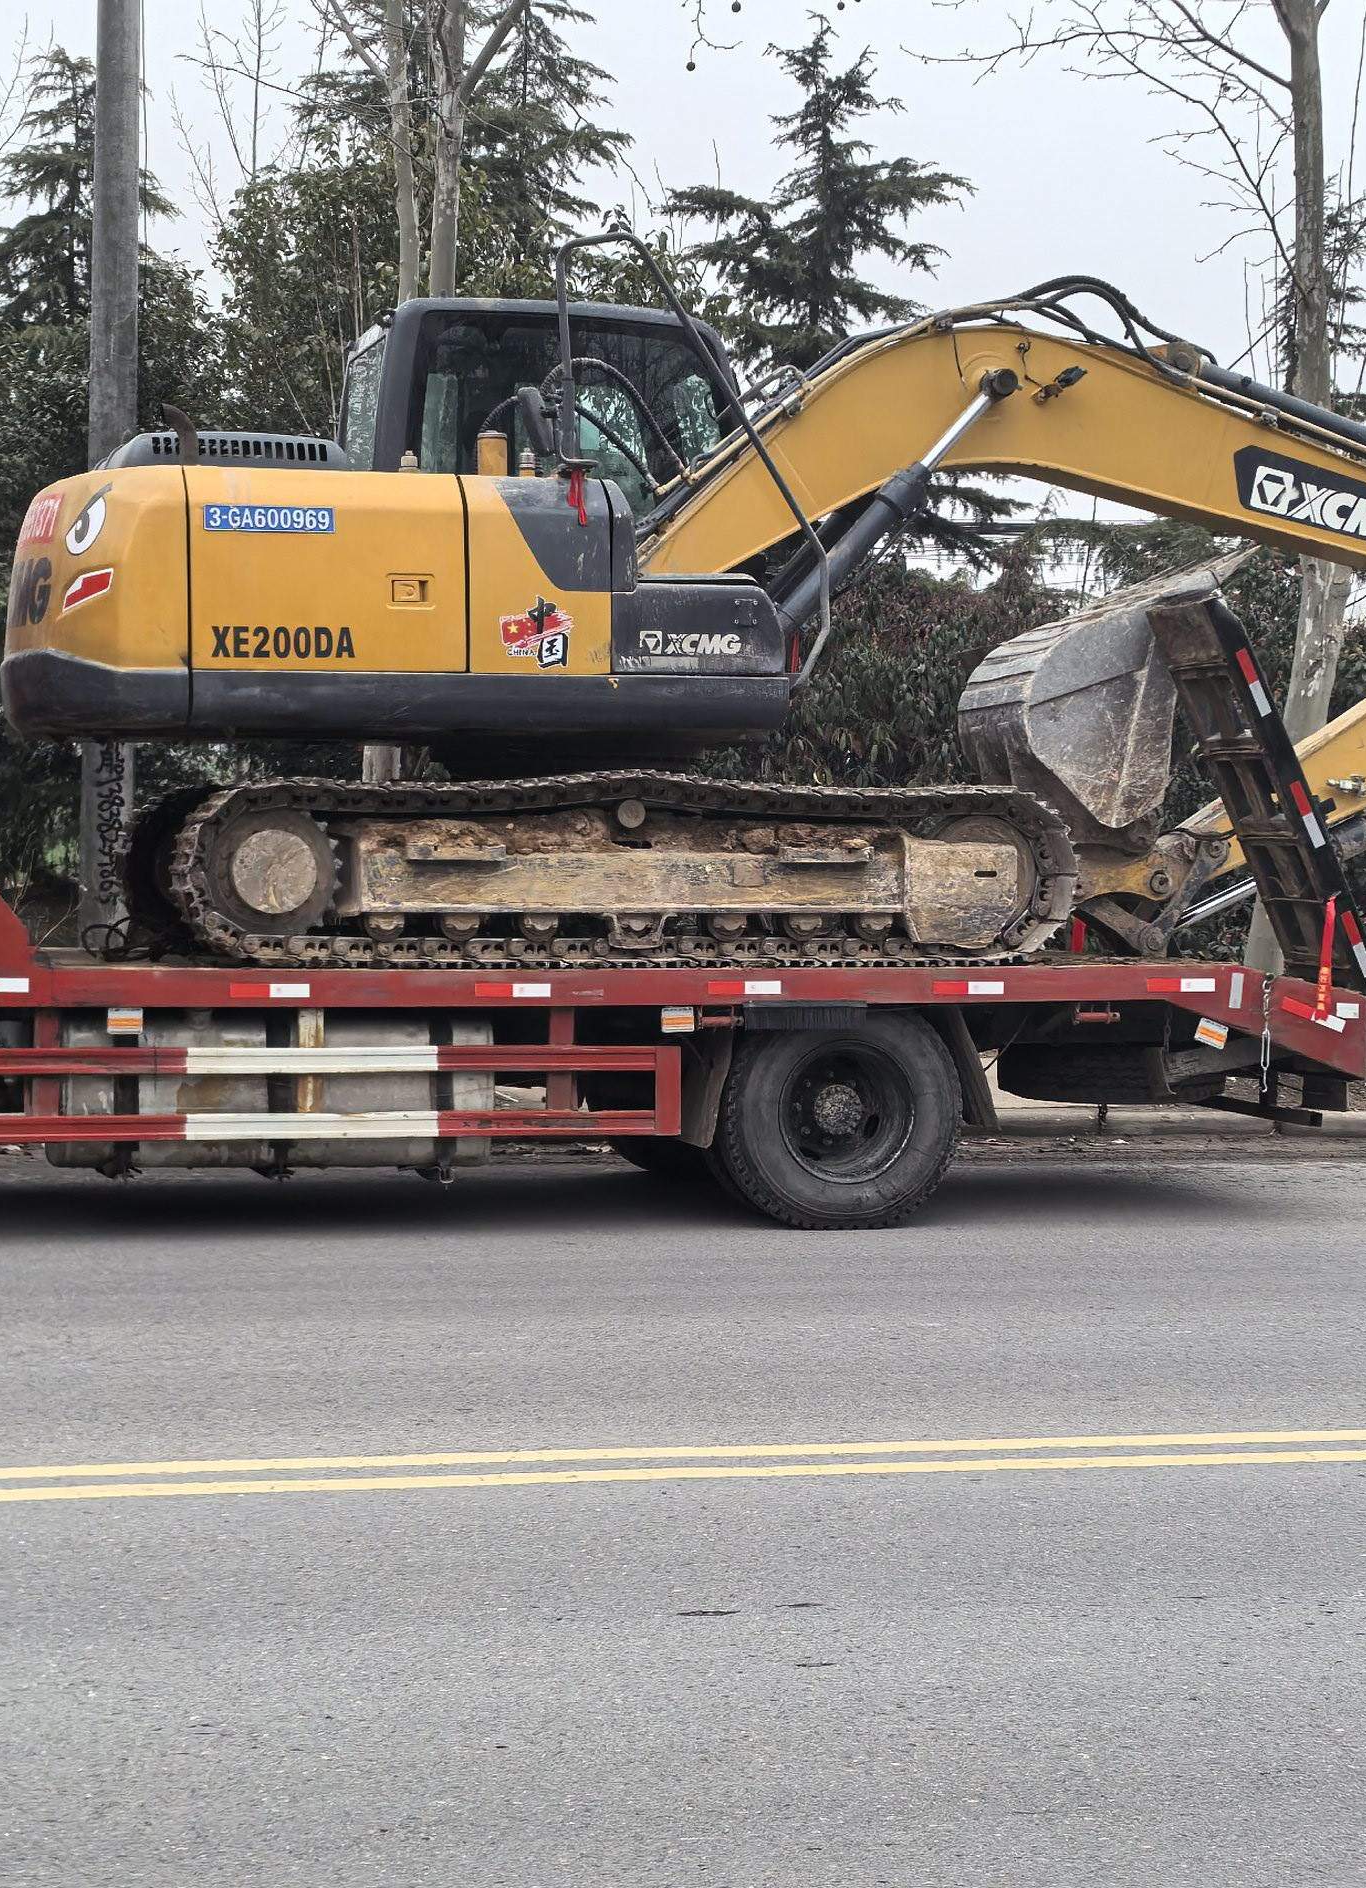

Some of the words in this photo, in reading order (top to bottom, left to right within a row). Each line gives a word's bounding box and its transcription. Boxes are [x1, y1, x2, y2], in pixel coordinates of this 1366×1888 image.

[209, 507, 330, 530] 3-GA600969
[211, 626, 355, 659] XE200DA
[507, 648, 535, 656] CHINA
[664, 633, 742, 655] XCMG
